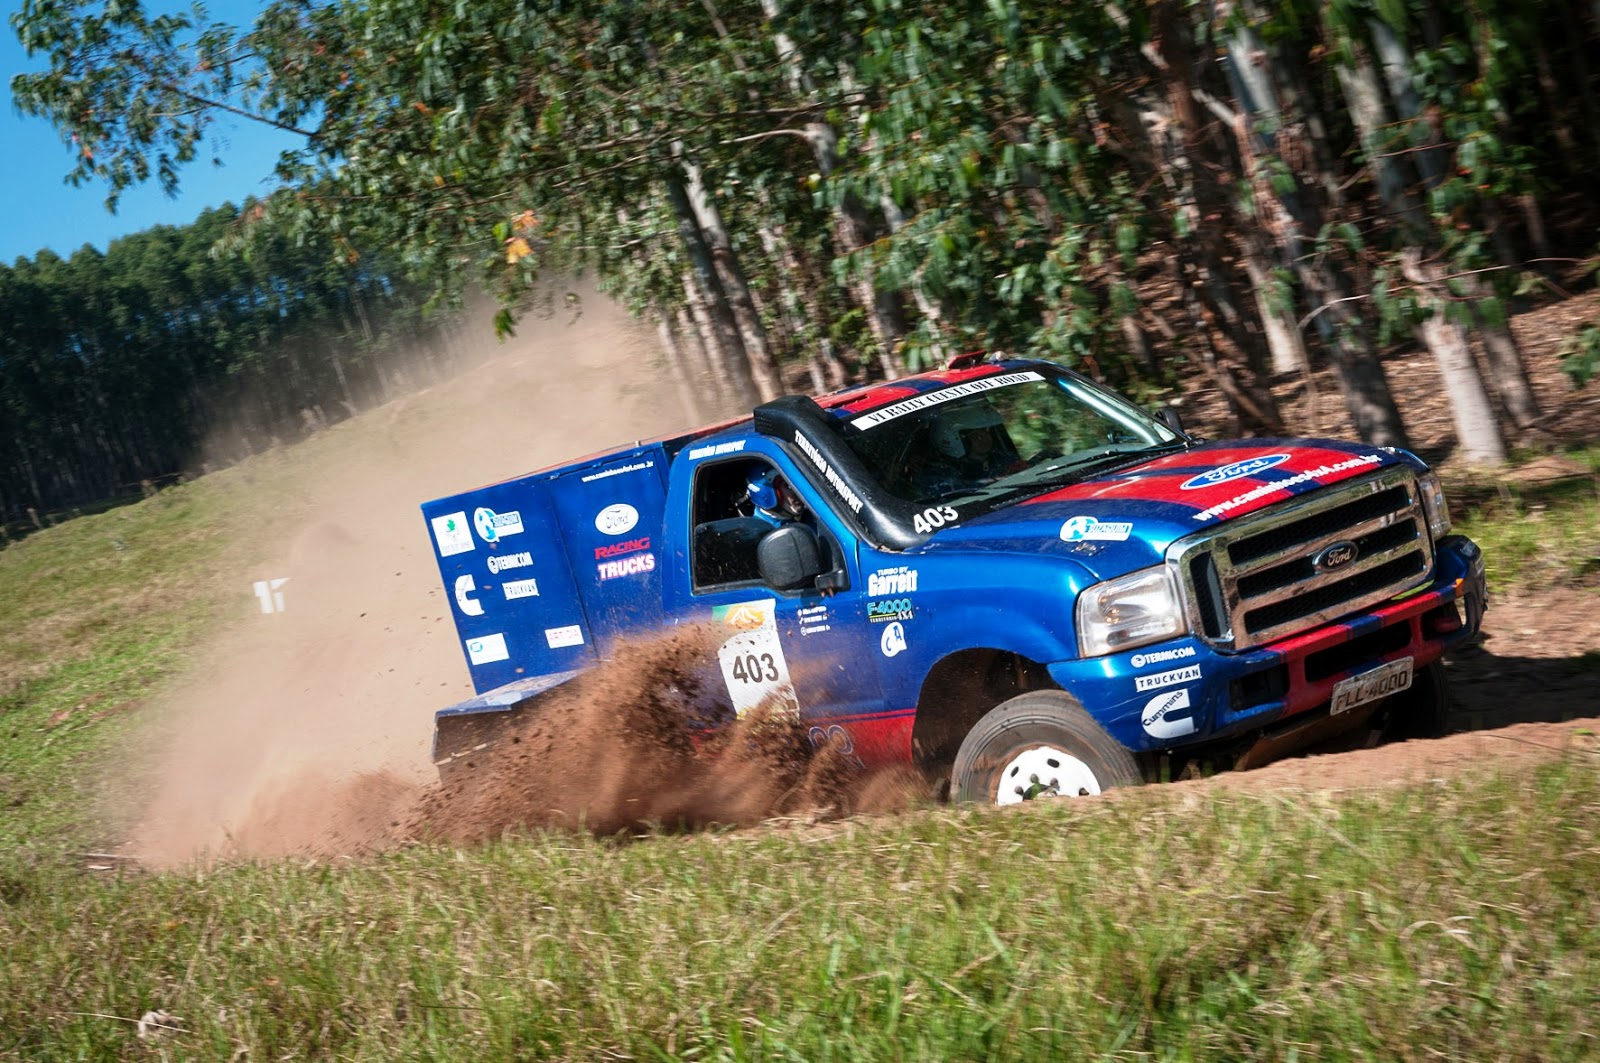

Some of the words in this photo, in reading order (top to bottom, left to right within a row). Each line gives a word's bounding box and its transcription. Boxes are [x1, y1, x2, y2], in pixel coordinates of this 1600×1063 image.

[868, 410, 886, 423] VI
[886, 398, 926, 417] RALLY
[926, 386, 972, 404] CUESTA
[970, 380, 995, 392] OFF
[994, 373, 1031, 386] ROAD
[1204, 458, 1270, 482] Ford
[825, 464, 864, 514] MOTORSPORT
[913, 505, 959, 534] 403
[594, 536, 651, 560] RACING
[1327, 547, 1352, 567] Ford
[597, 552, 656, 581] TRUCKS
[868, 570, 918, 597] Garrett
[866, 598, 912, 616] F-4000
[732, 652, 780, 684] 403
[1143, 646, 1197, 665] TERMICOM
[1138, 668, 1200, 688] TRUCKVAN
[1142, 690, 1184, 727] Cummins
